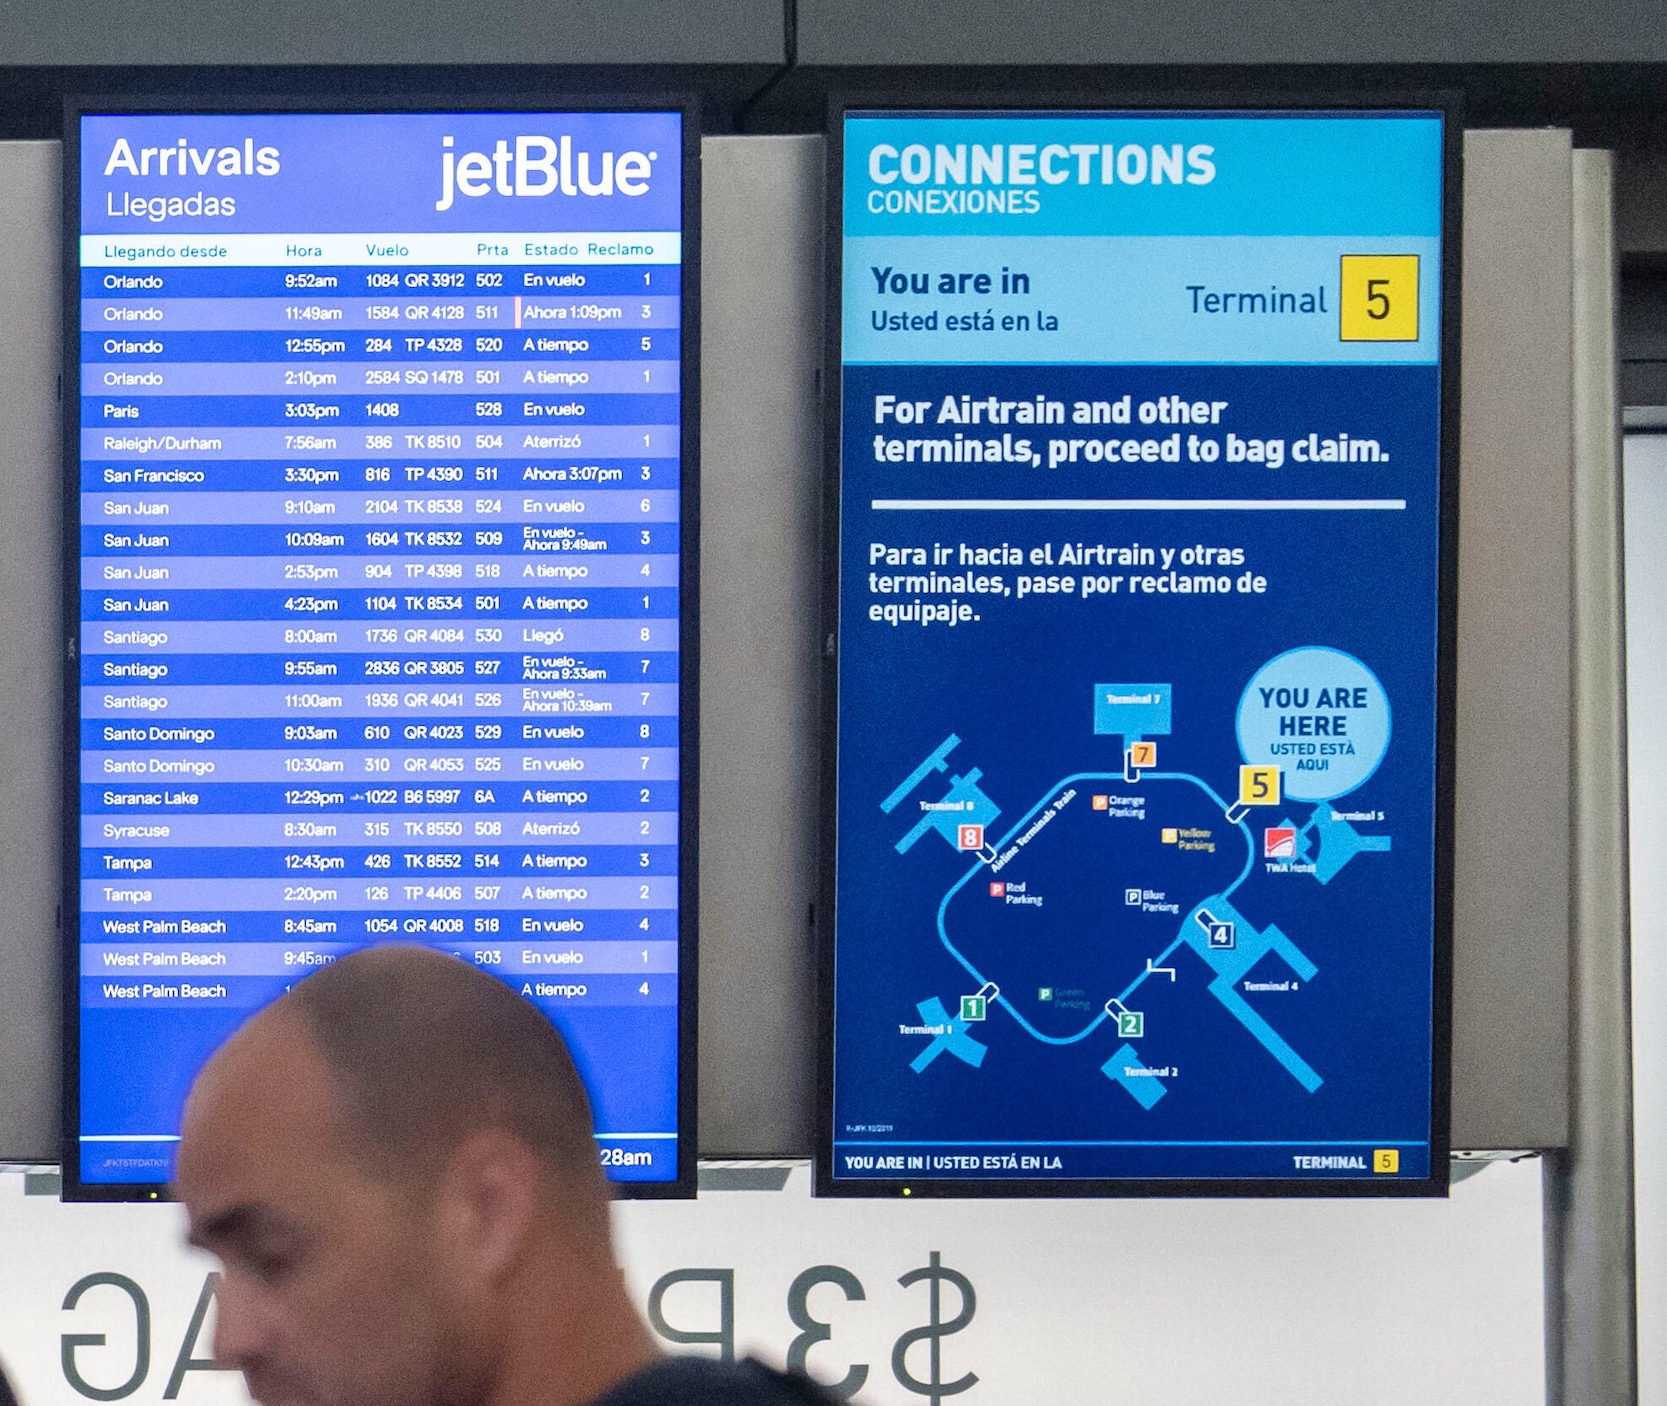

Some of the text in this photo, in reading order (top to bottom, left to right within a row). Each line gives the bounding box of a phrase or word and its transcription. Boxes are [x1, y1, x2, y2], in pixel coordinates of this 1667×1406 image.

[103, 137, 281, 176] Arrivals
[867, 143, 1217, 186] CONNECTIONS
[107, 191, 236, 223] Llegadas
[867, 189, 1041, 215] CONEXIONES
[870, 266, 1030, 295] You are in
[1185, 279, 1390, 320] Terminal 5
[871, 308, 1059, 332] Usted está en la
[875, 394, 1229, 425] For Airtrain and other
[872, 432, 1390, 469] terminals, proceed to bag claim.
[869, 542, 1245, 570] Para ir hacia el Airtrain y otras
[868, 570, 1268, 599] terminales, pase por reclamo de
[868, 598, 981, 627] equipaje.
[1106, 693, 1152, 705] Terminal
[1258, 687, 1368, 709] YOU ARE
[1279, 715, 1347, 737] HERE
[1138, 746, 1149, 763] 7
[1270, 742, 1316, 756] USTED
[1296, 758, 1329, 771] AQUI
[1252, 771, 1270, 799] 5
[919, 799, 965, 811] Terminal
[1330, 810, 1376, 821] Terminal
[103, 820, 650, 841] Syracuse 8:30am 315 TK 8550 508 Aterrizó 2
[963, 828, 978, 847] 8
[990, 789, 1077, 874] Airline Terminals Train
[1214, 926, 1228, 944] 4
[1243, 980, 1289, 991] Terminal
[967, 999, 978, 1017] 1
[898, 1023, 945, 1035] Terminal
[1124, 1015, 1137, 1033] 2
[1123, 1066, 1170, 1077] Terminal
[844, 1156, 923, 1170] YOU ARE IN
[933, 1152, 1063, 1170] USTED ESTÁ EN LA
[1292, 1155, 1368, 1170] TERMINAL
